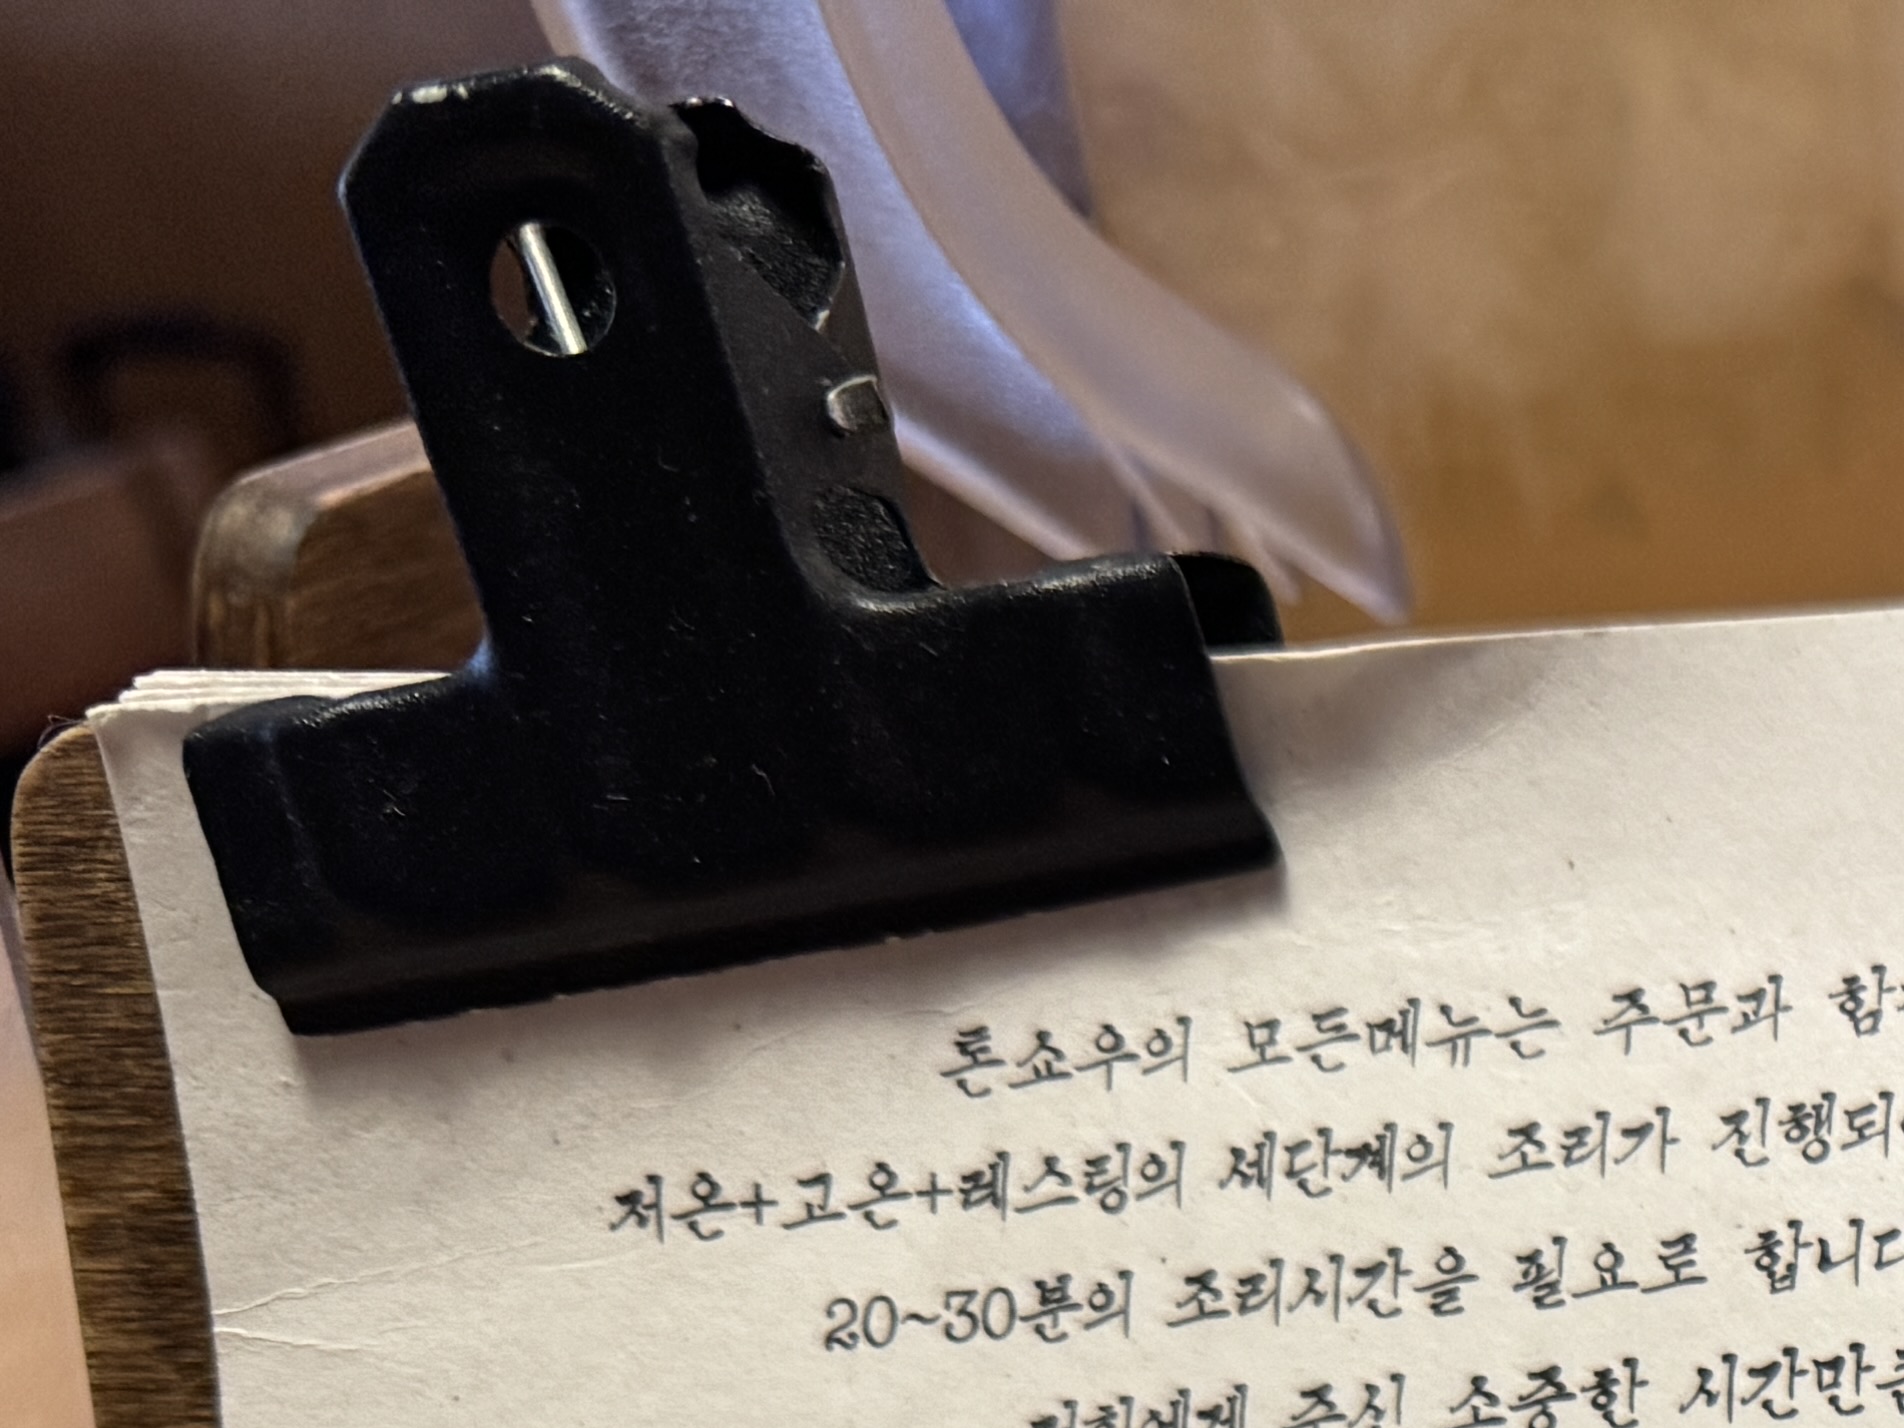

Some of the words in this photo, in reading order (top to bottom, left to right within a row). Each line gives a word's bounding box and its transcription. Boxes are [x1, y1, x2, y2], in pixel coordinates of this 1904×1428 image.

[939, 1014, 1192, 1098] 톤쇼우의
[1226, 995, 1561, 1073] 모든메뉴는
[1593, 972, 1793, 1056] 주문과
[608, 1138, 1186, 1243] 저온+고온+레스팅의
[1217, 1120, 1454, 1201] 세단계의
[1487, 1105, 1680, 1179] 조리가
[822, 1269, 1134, 1352] 20~30분의
[1161, 1245, 1480, 1328] 조리시간을
[1511, 1231, 1708, 1310] 필요로
